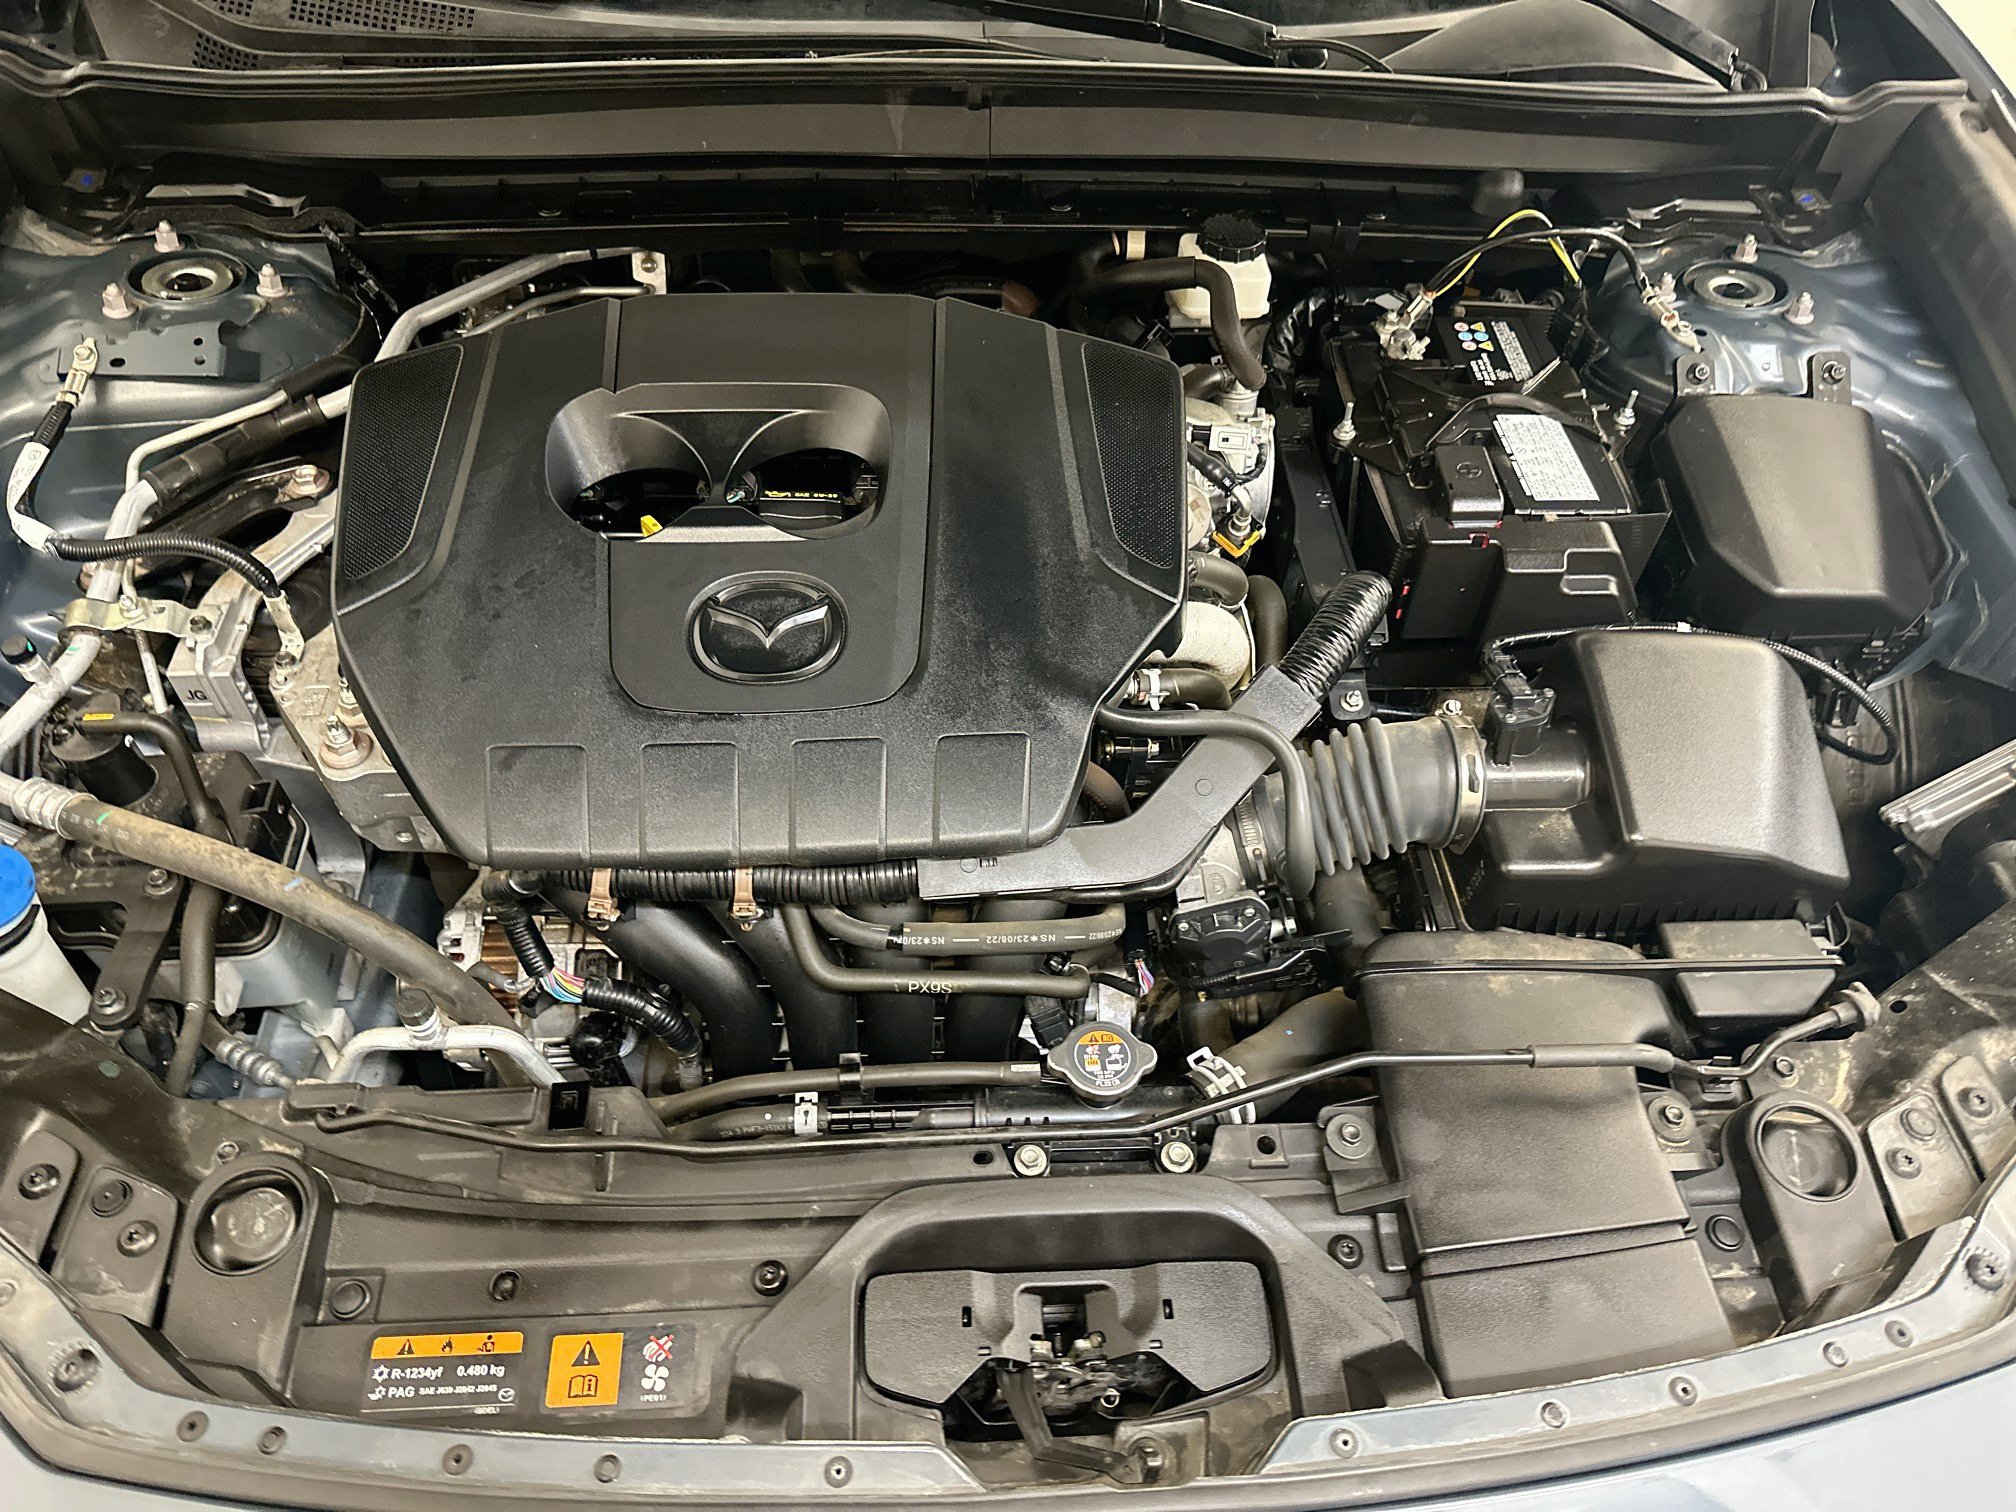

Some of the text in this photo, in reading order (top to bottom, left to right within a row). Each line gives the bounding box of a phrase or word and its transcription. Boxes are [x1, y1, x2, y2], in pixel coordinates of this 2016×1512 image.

[187, 690, 208, 700] JG
[908, 980, 952, 994] PX9S
[390, 1364, 506, 1380] R-1234yf 0.480 kg
[387, 1387, 415, 1398] PAG
[419, 1387, 435, 1395] SAE
